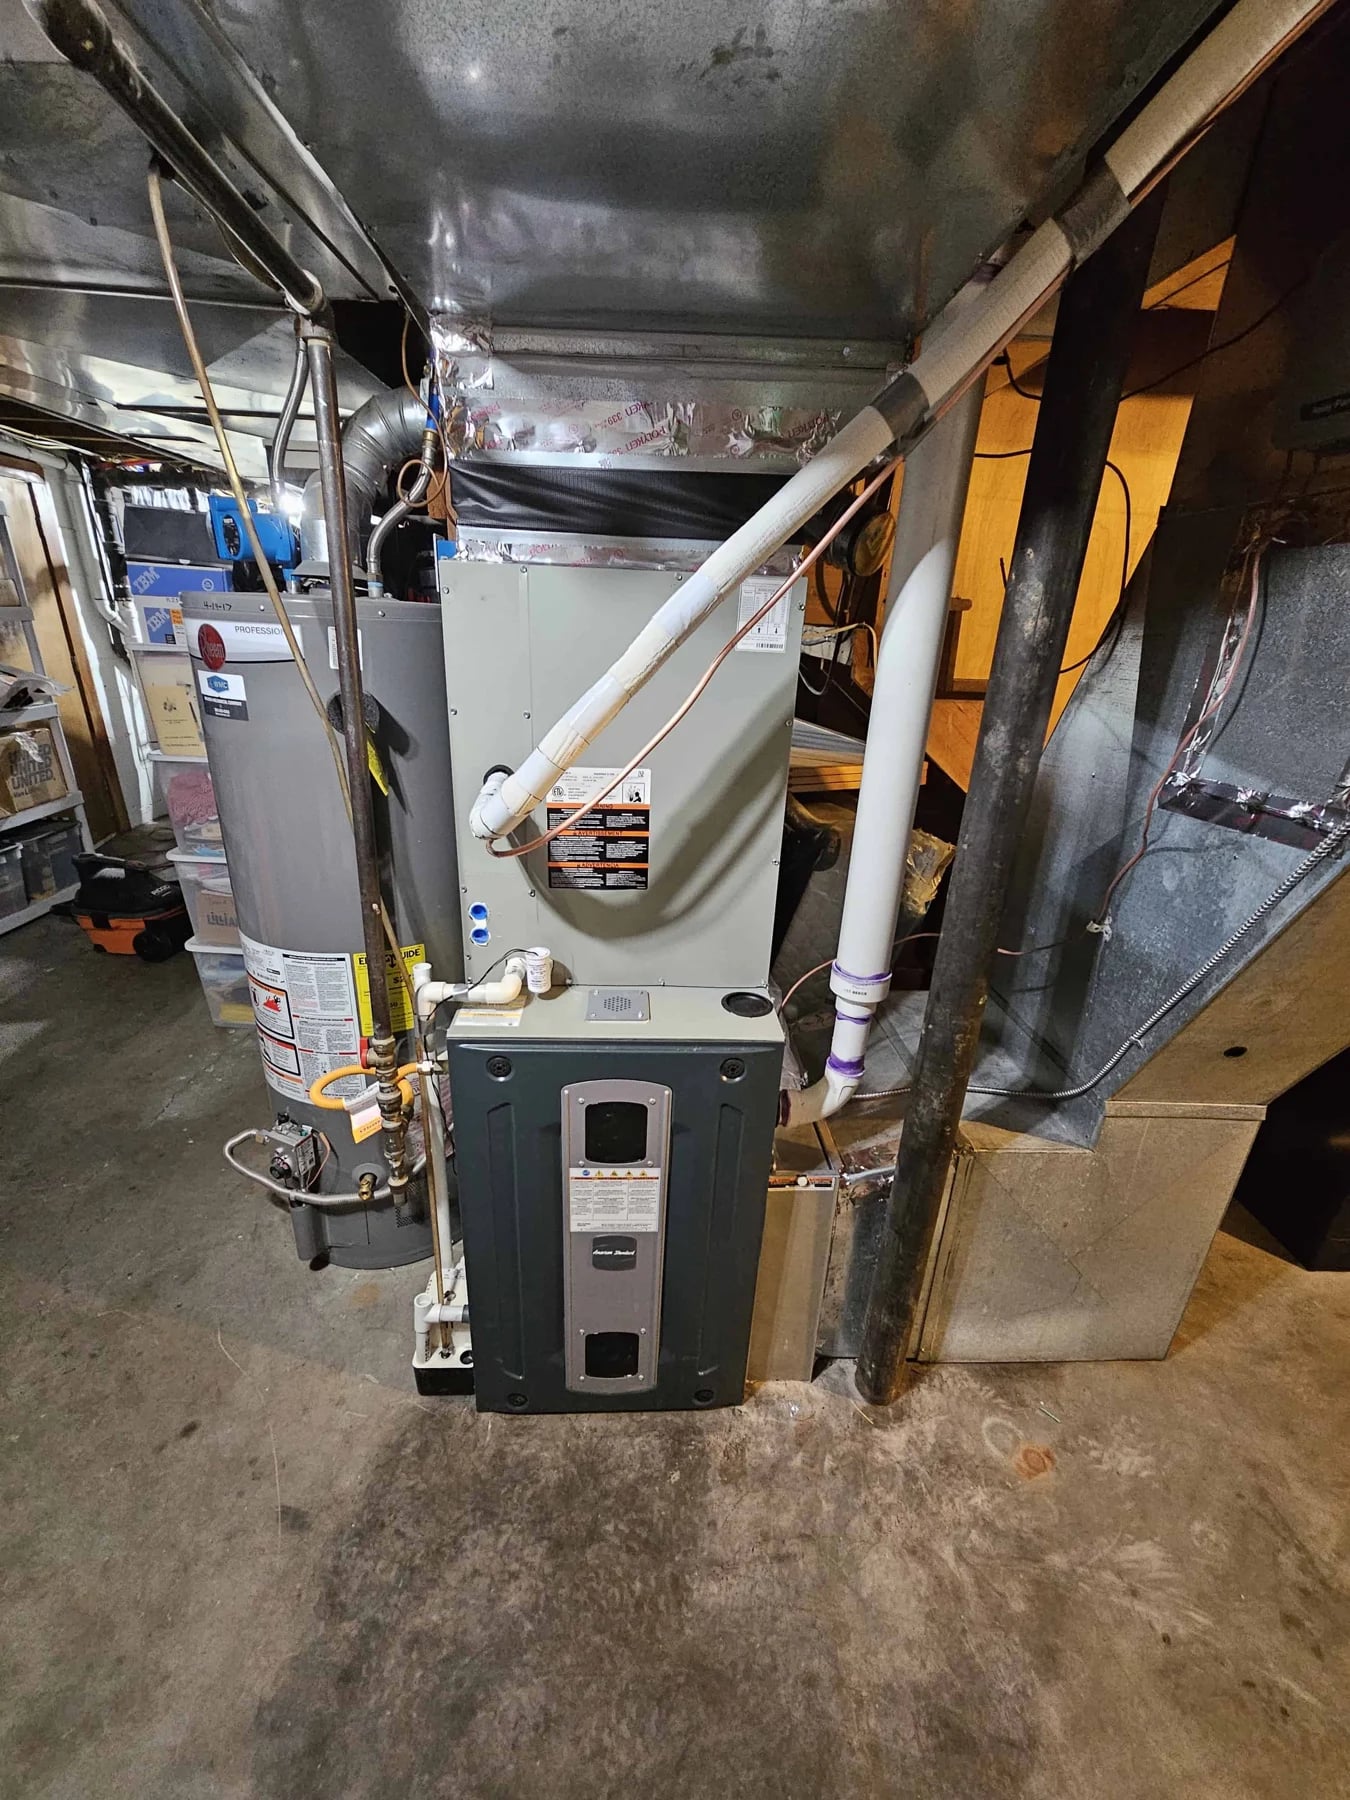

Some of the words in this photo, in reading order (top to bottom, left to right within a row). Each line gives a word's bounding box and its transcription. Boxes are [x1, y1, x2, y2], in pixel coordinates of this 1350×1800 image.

[132, 566, 161, 594] IBM
[146, 607, 171, 632] IBM
[234, 625, 283, 636] PROFESSIO
